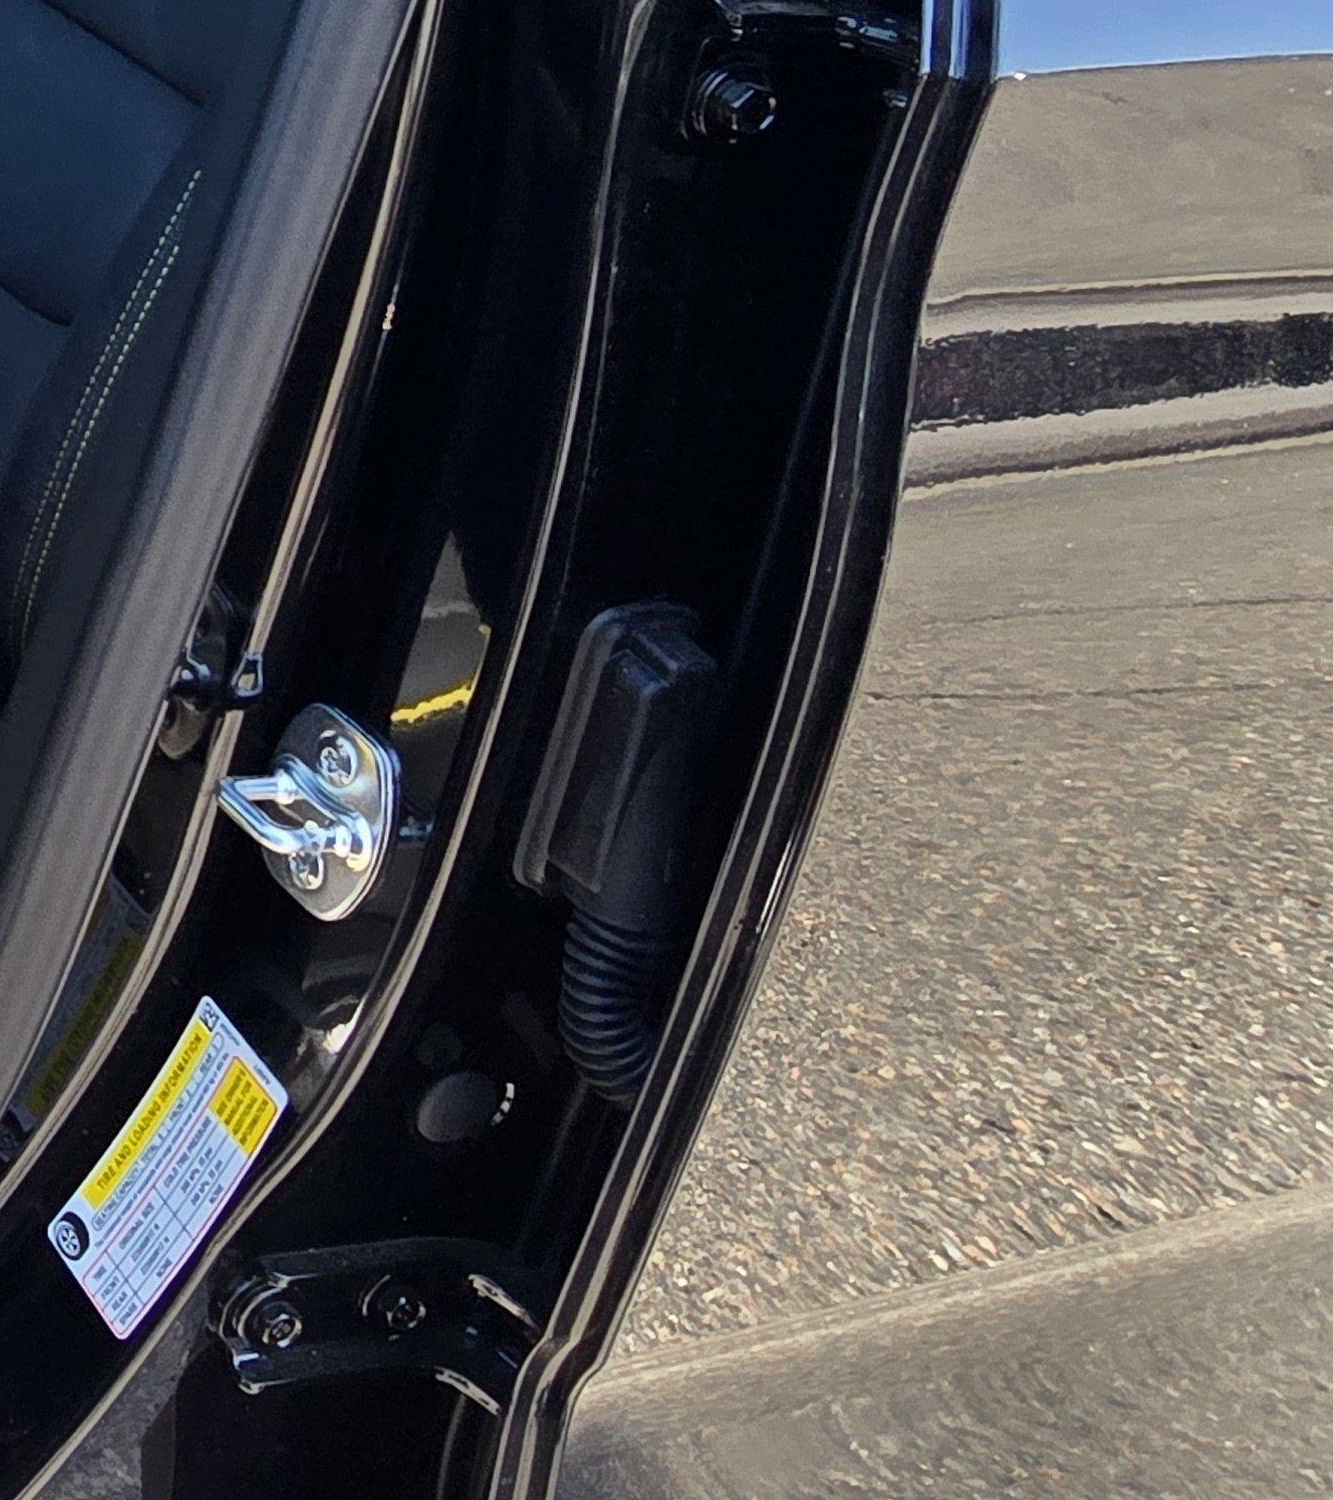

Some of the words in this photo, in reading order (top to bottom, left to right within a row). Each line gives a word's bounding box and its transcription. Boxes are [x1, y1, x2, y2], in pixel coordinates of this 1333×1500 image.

[97, 1165, 115, 1190] TIRE
[114, 1144, 130, 1168] AND
[129, 1099, 160, 1146] LOADING
[158, 1033, 201, 1102] INFORMATION
